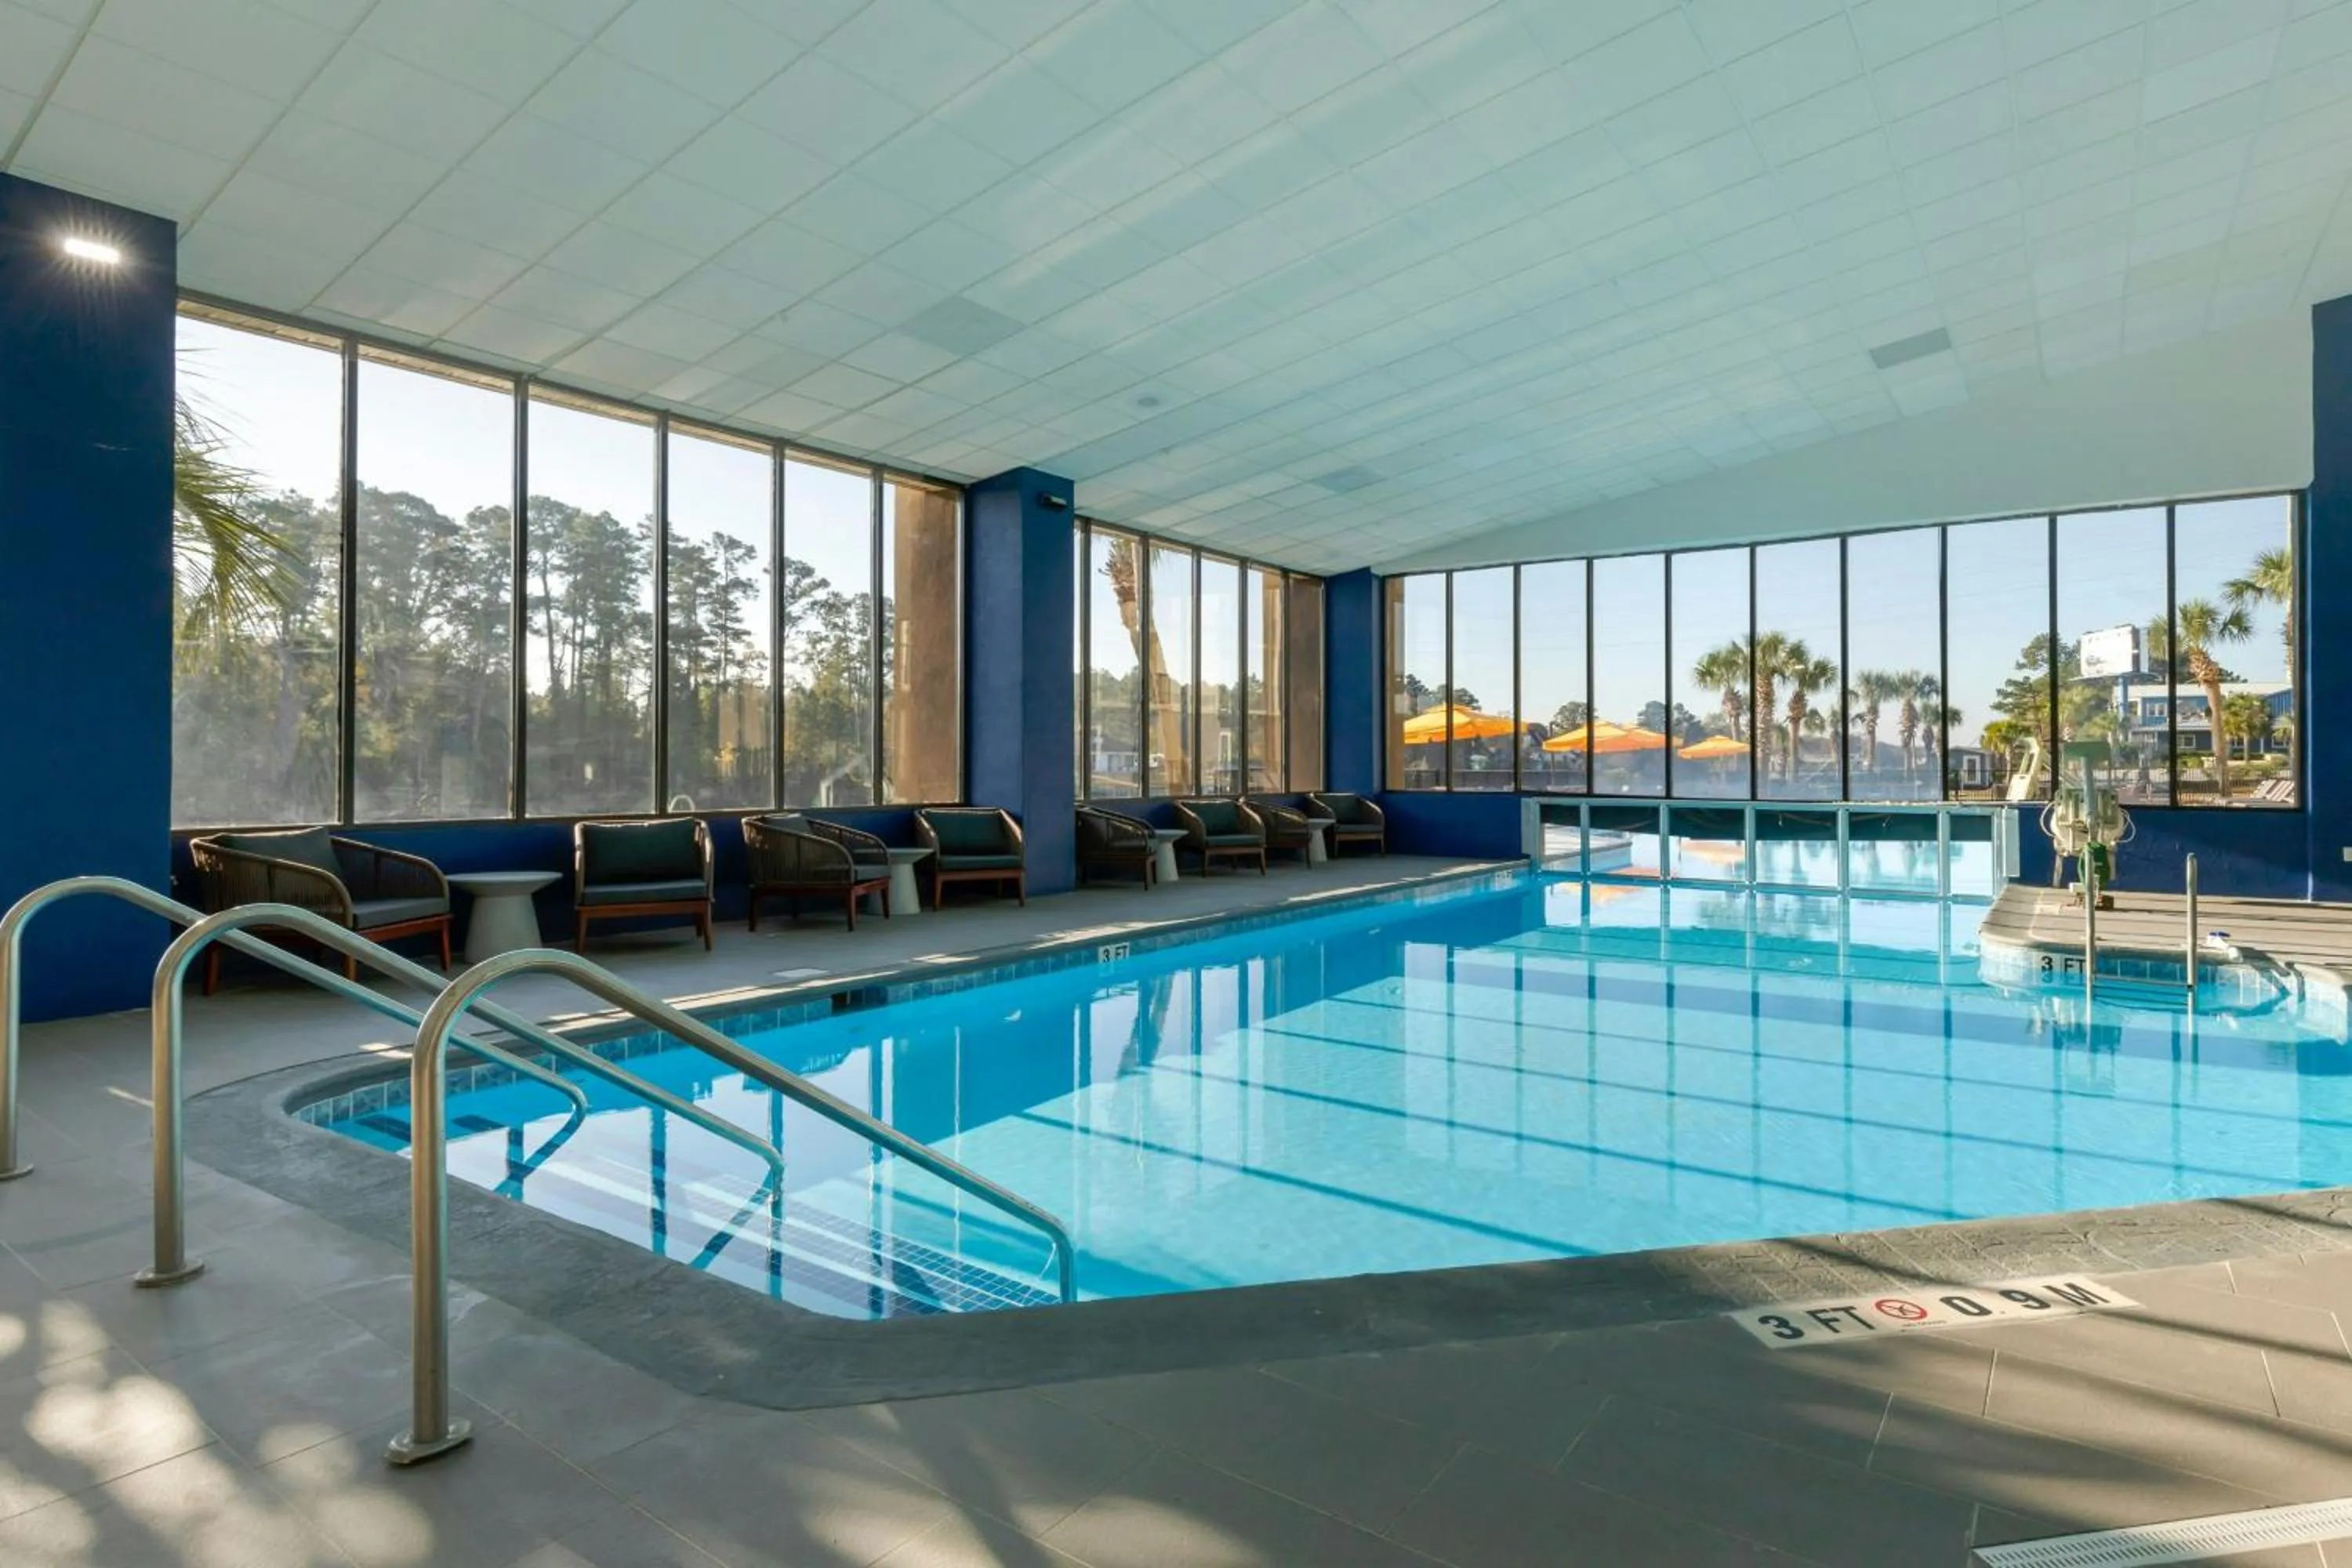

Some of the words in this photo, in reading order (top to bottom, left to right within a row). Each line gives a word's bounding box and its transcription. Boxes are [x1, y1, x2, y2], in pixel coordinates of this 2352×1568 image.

[1115, 946, 1127, 960] FT
[2041, 956, 2053, 972] 3
[2064, 957, 2086, 974] FT
[1758, 1315, 1805, 1339] 3
[1806, 1305, 1875, 1333] FT
[2042, 1283, 2111, 1307] M
